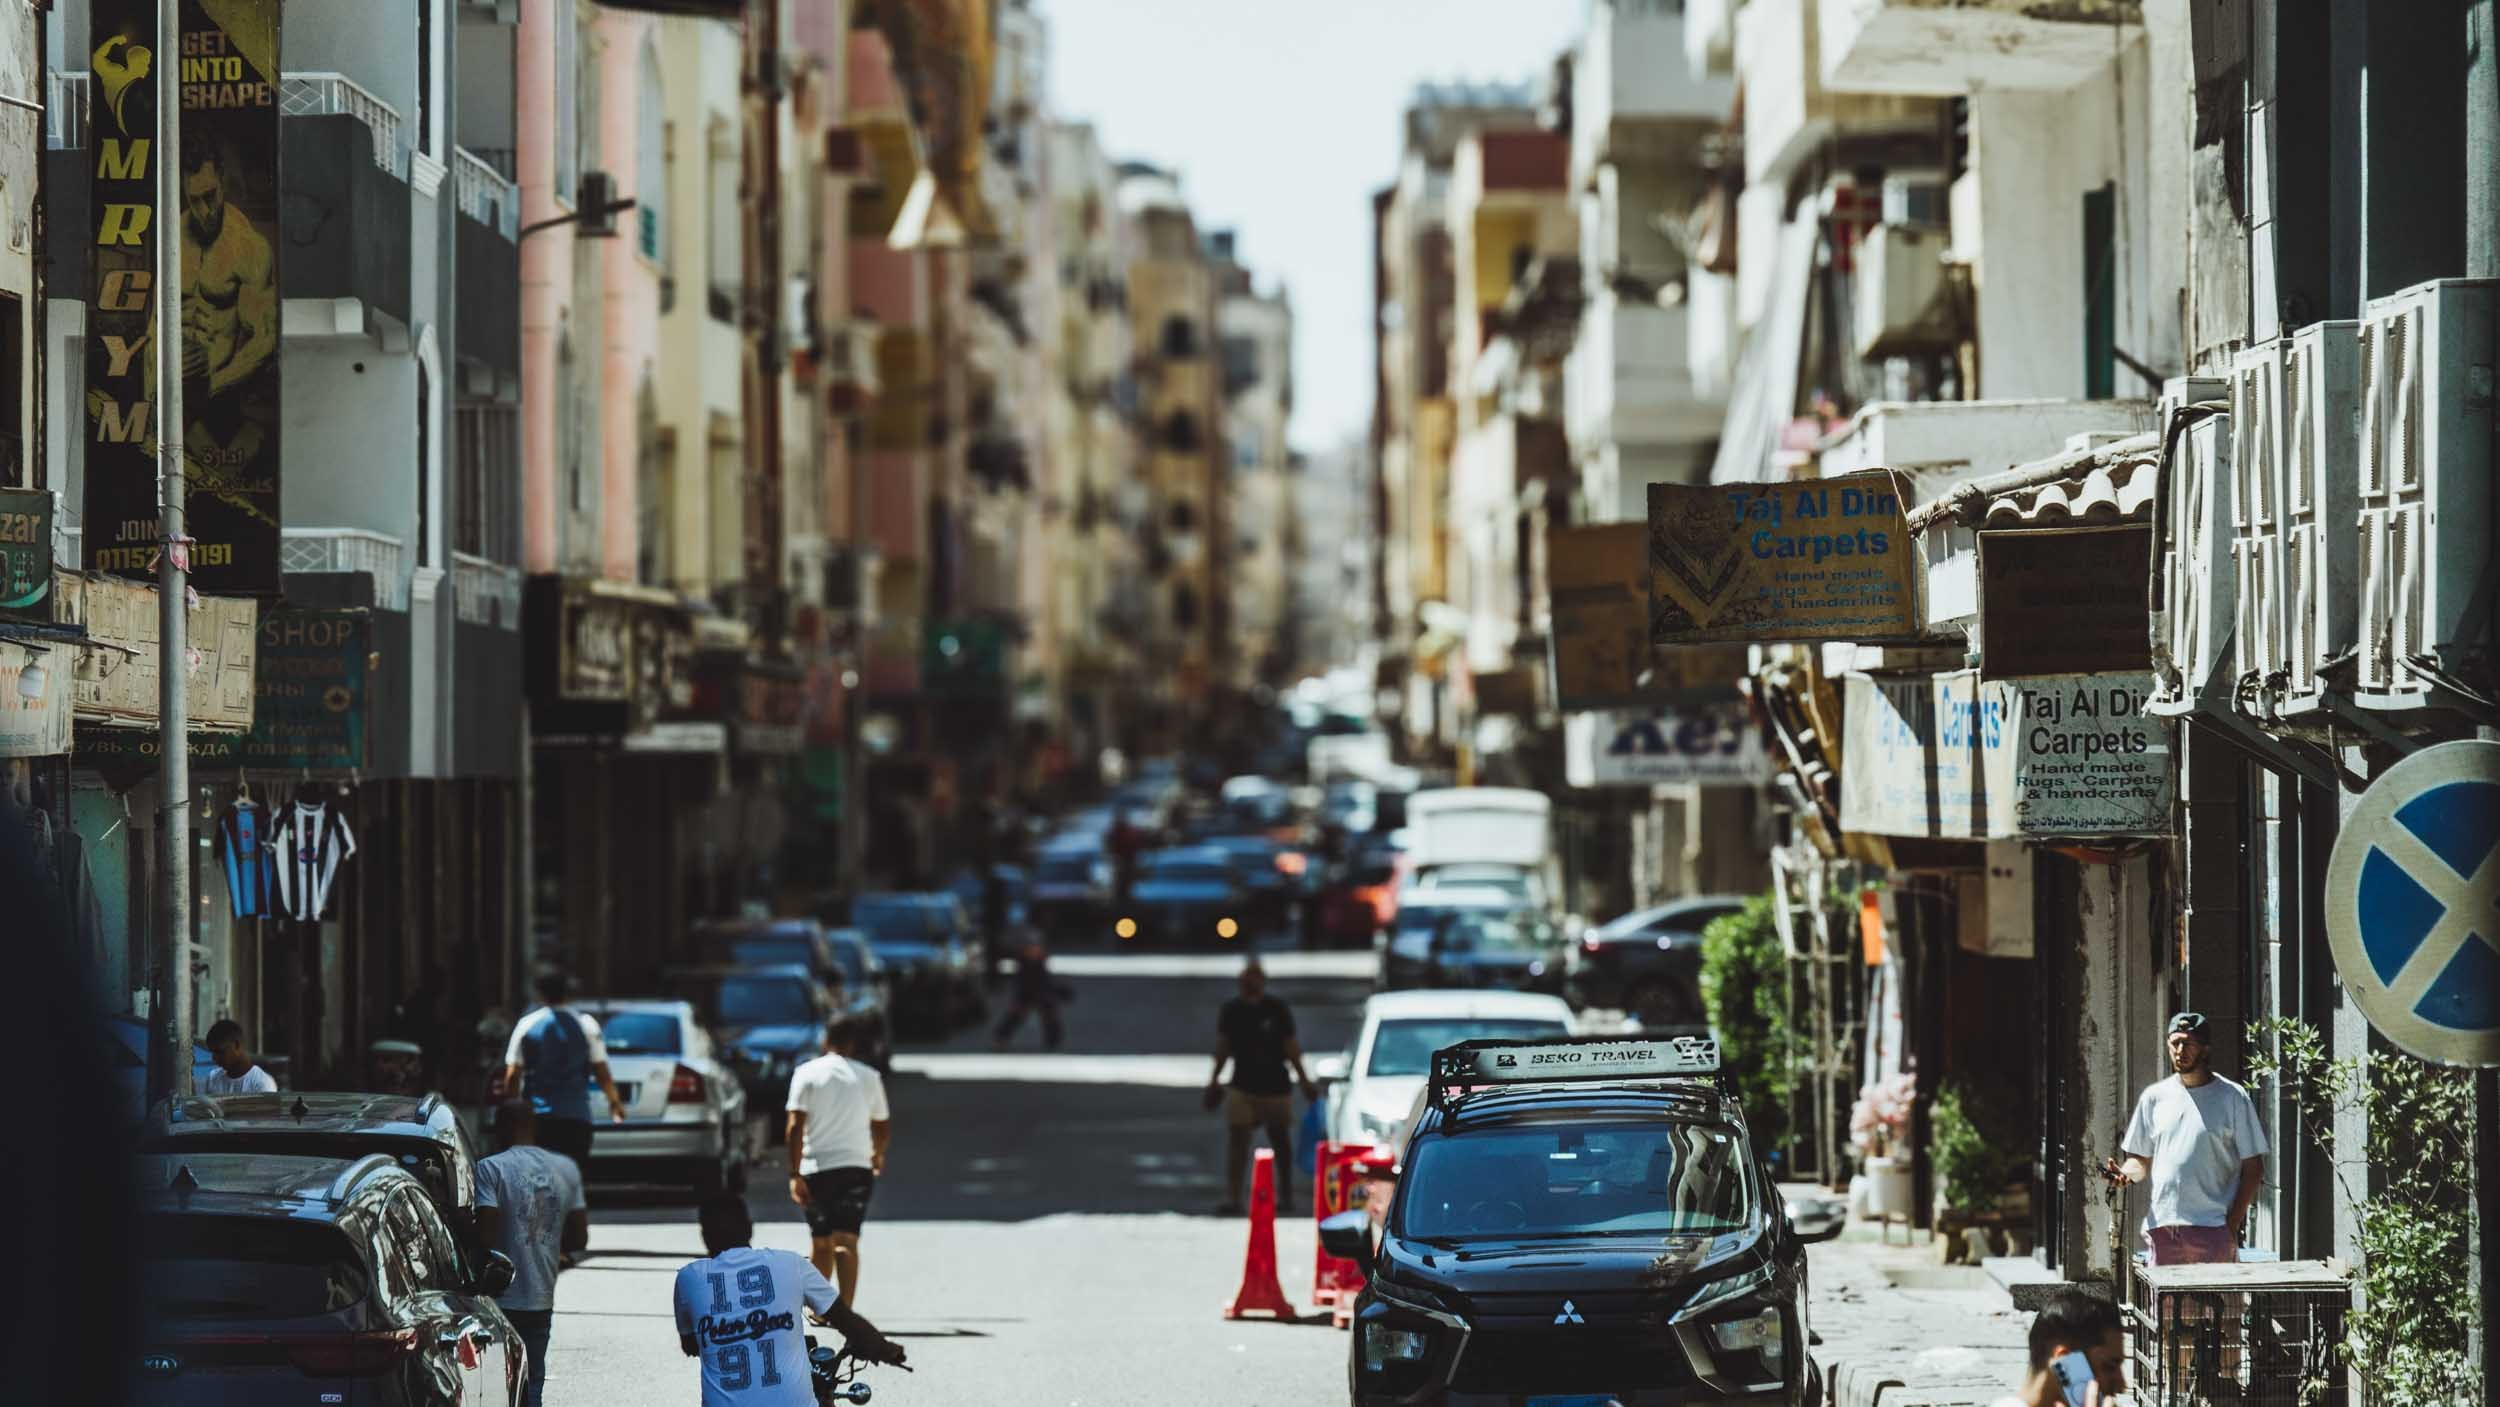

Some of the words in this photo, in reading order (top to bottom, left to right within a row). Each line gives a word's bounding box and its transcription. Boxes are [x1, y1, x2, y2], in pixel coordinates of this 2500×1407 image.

[183, 31, 230, 57] GET
[182, 56, 243, 82] INTO
[182, 82, 273, 110] SHAPE
[1728, 492, 1783, 530] Taj
[1795, 489, 1829, 520] Al
[1840, 487, 1898, 518] Din
[115, 520, 161, 543] JOIN
[1751, 527, 1890, 564] Carpets
[1776, 569, 1825, 583] Hand
[1831, 567, 1885, 581] made
[264, 619, 354, 649] SHOP
[2020, 689, 2062, 725] Taj
[2071, 688, 2099, 718] Al
[2030, 726, 2148, 762] Carpets
[2016, 776, 2066, 790] Rugs
[2082, 774, 2164, 788] Carpets
[2031, 762, 2085, 775] Hand
[2090, 762, 2147, 774] made
[2026, 788, 2042, 800] &
[2047, 786, 2157, 800] handcrafts
[1530, 1052, 1583, 1065] BEKO
[1591, 1049, 1657, 1062] TRAVEL
[707, 1264, 776, 1315] 19
[717, 1339, 782, 1391] 91
